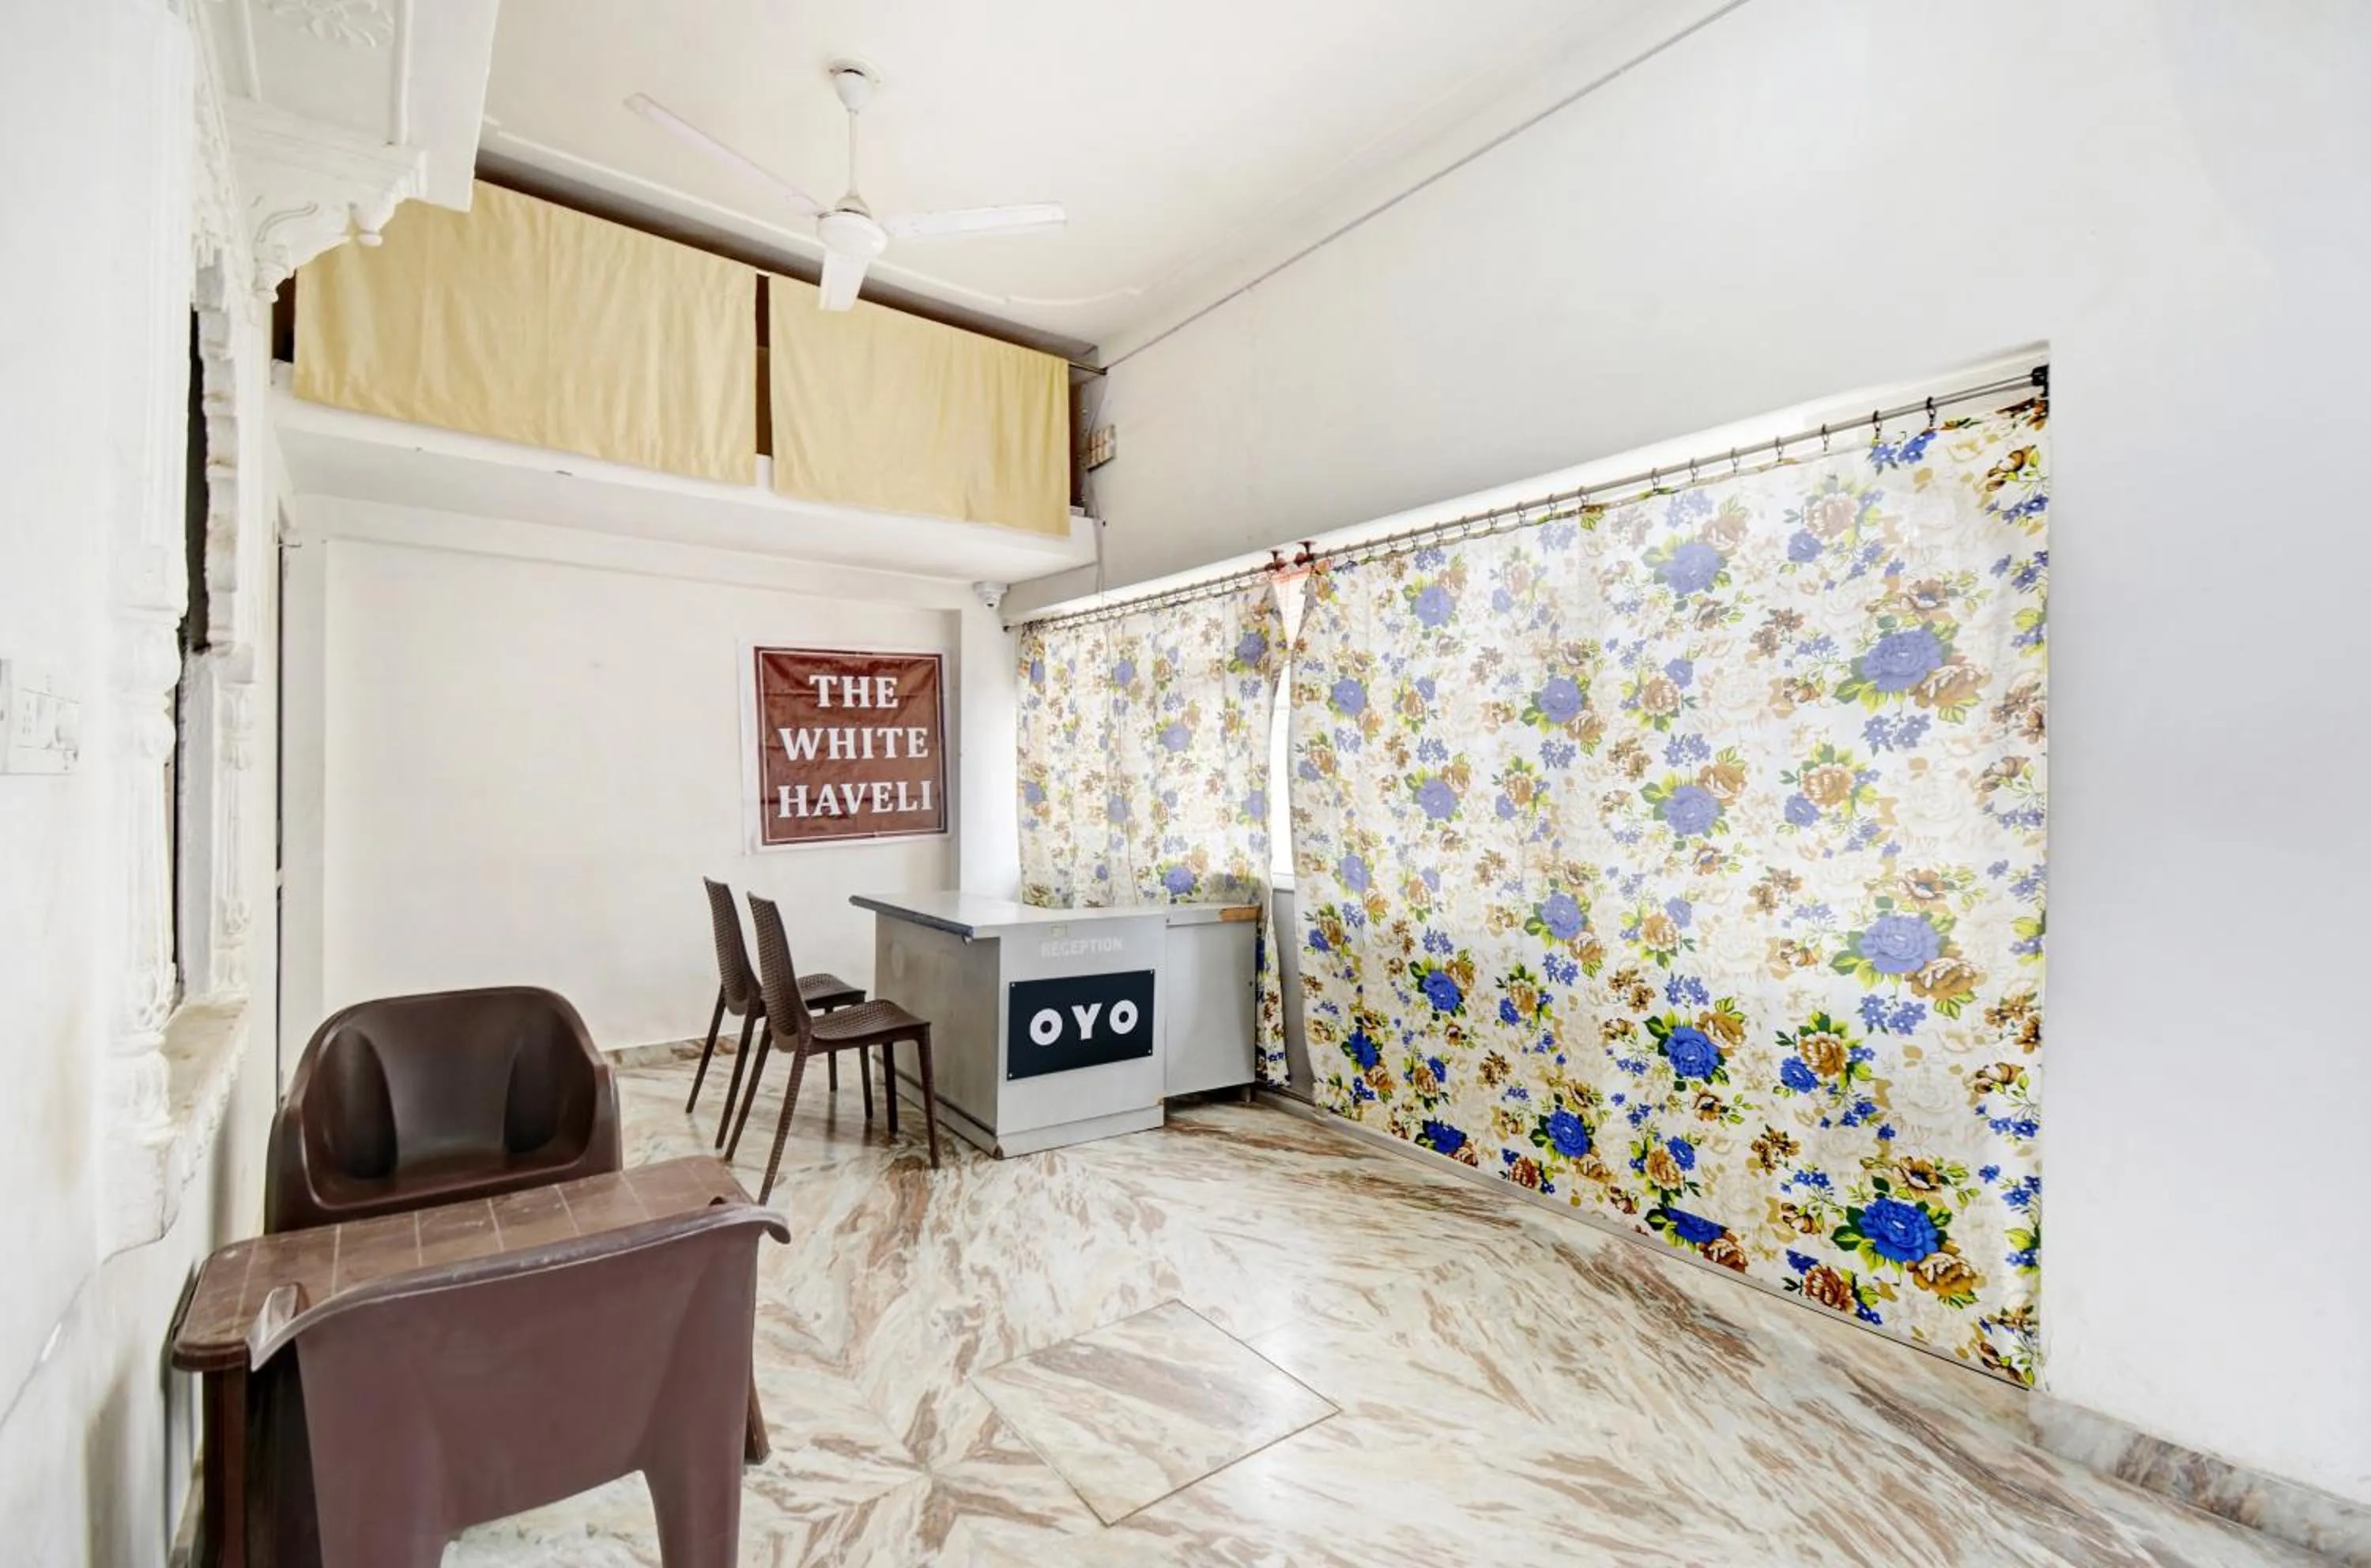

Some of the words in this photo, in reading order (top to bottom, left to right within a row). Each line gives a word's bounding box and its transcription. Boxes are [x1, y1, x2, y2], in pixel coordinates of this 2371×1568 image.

[808, 674, 899, 708] THE
[778, 727, 929, 761] WHITE
[777, 780, 933, 818] HAVELI
[1040, 937, 1123, 958] RECEPTION
[1029, 999, 1139, 1046] OYO
